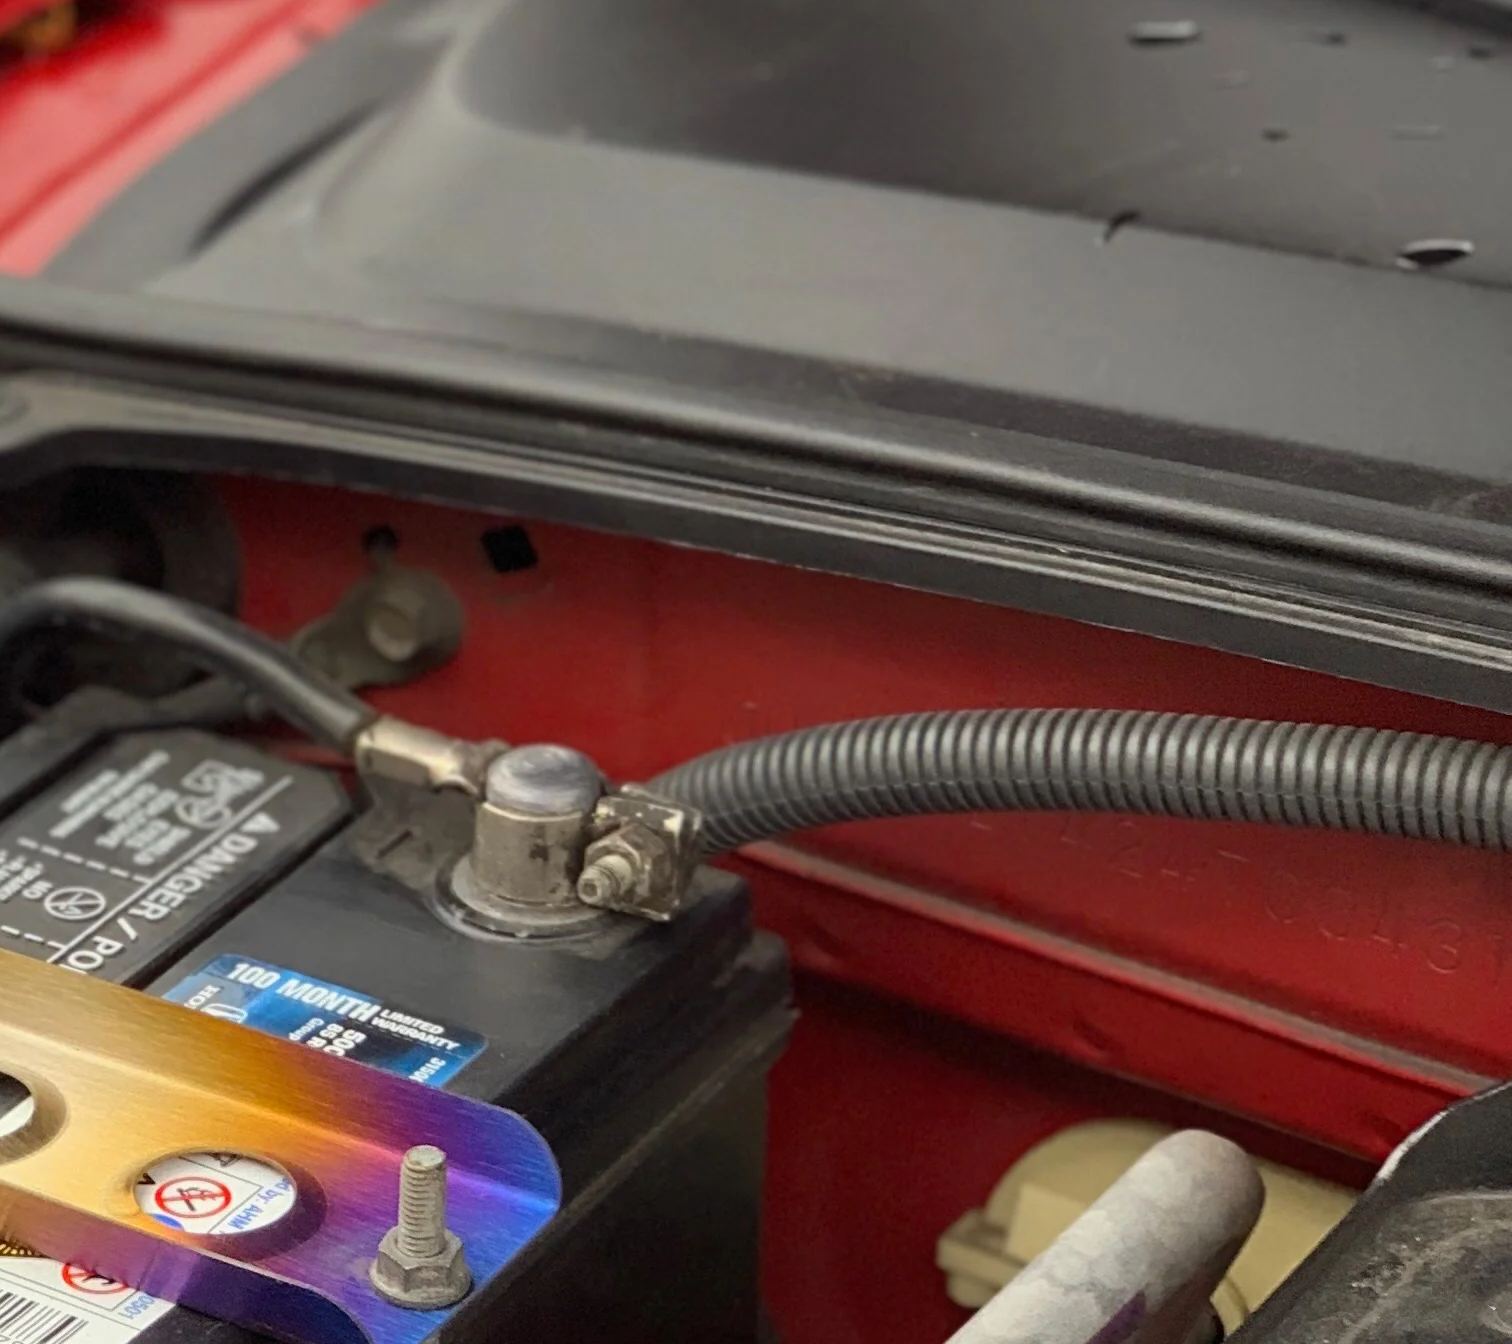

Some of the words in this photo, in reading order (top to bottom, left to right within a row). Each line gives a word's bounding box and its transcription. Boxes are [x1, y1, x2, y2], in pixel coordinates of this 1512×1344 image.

[129, 834, 256, 920] DANGER
[227, 963, 281, 989] 100
[276, 979, 380, 1021] MONTH
[371, 1017, 460, 1050] WARRANTY
[380, 1009, 444, 1034] LIMITED
